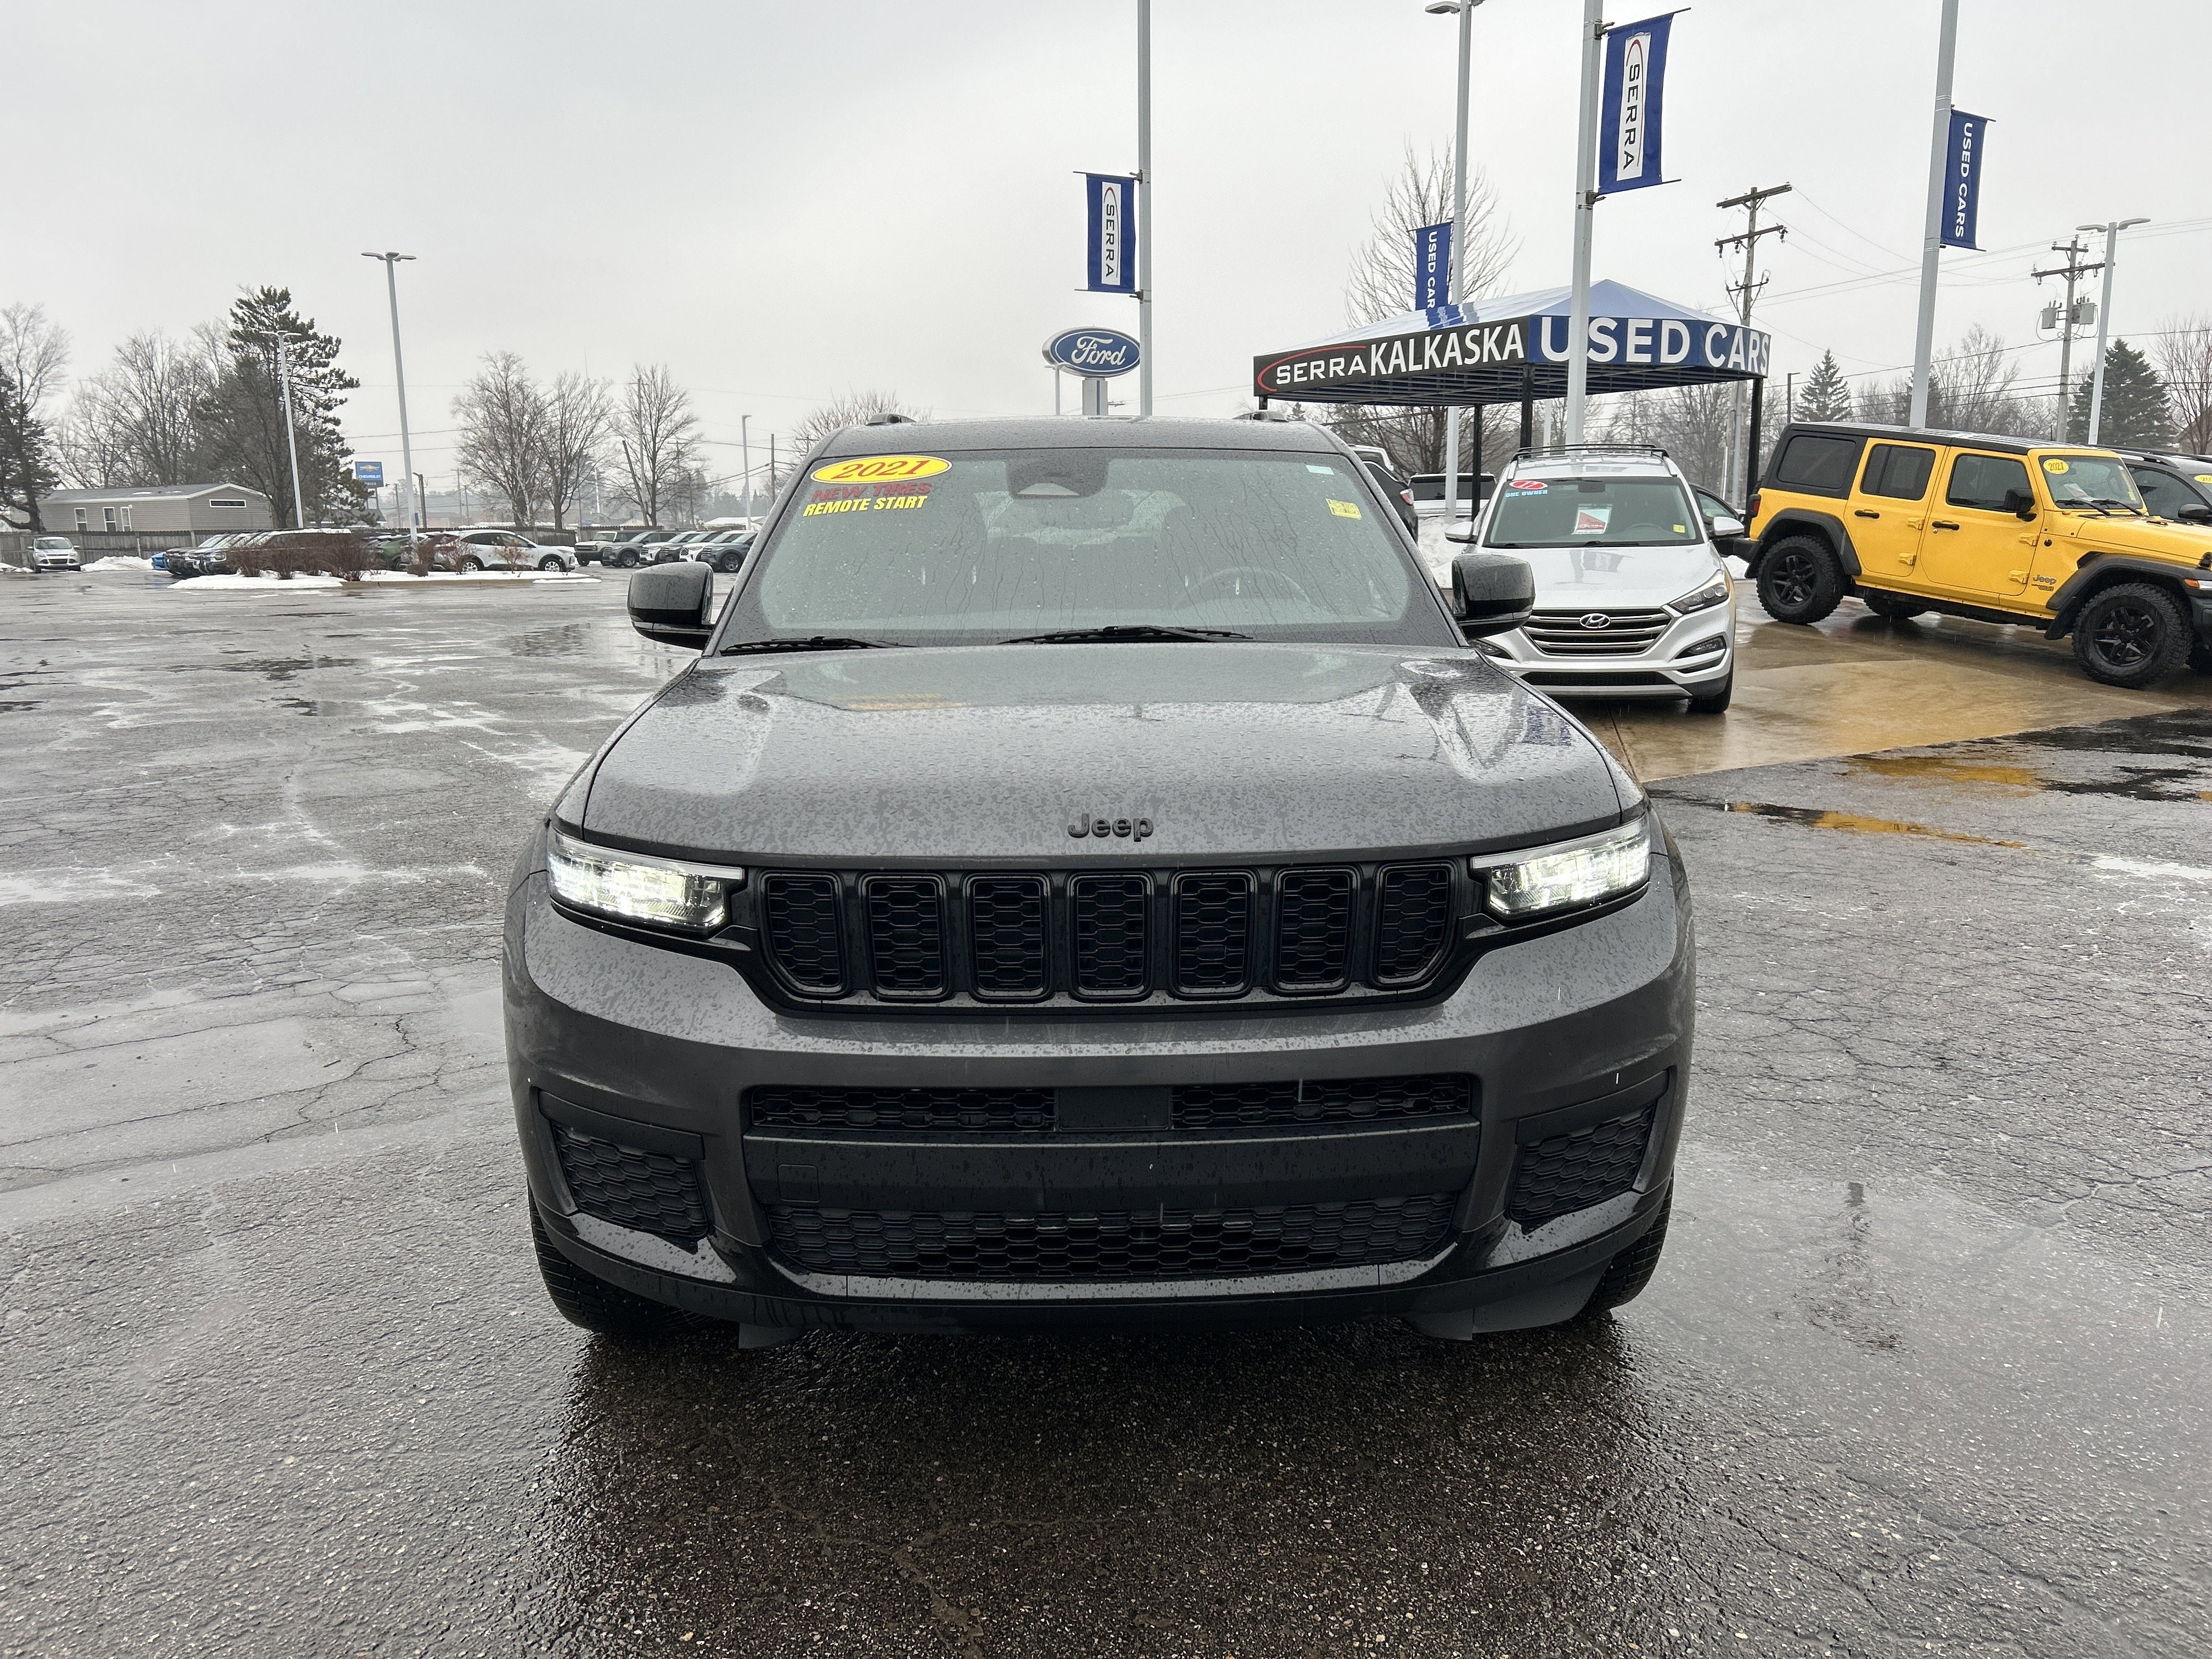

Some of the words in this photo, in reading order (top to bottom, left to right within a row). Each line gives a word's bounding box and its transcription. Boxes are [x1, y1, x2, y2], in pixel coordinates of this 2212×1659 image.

[1623, 64, 1640, 170] SERRA
[1961, 122, 1973, 177] USED
[1955, 183, 1967, 238] CARS
[1105, 204, 1115, 278] SERRA
[1427, 231, 1437, 273] USED
[1427, 276, 1436, 309] CAR
[1071, 336, 1127, 366] Ford
[1276, 354, 1366, 385] SERRA
[1370, 324, 1525, 376] KALKASKA
[1541, 317, 1690, 363] USED
[1705, 323, 1769, 377] CARS
[831, 460, 931, 479] 2021
[2048, 462, 2064, 471] 2021
[803, 498, 871, 517] REMOTE
[873, 495, 928, 510] START
[811, 485, 868, 502] NEW
[873, 482, 932, 497] TIRES
[2033, 574, 2057, 585] Jeep
[1068, 812, 1154, 842] Jeep
